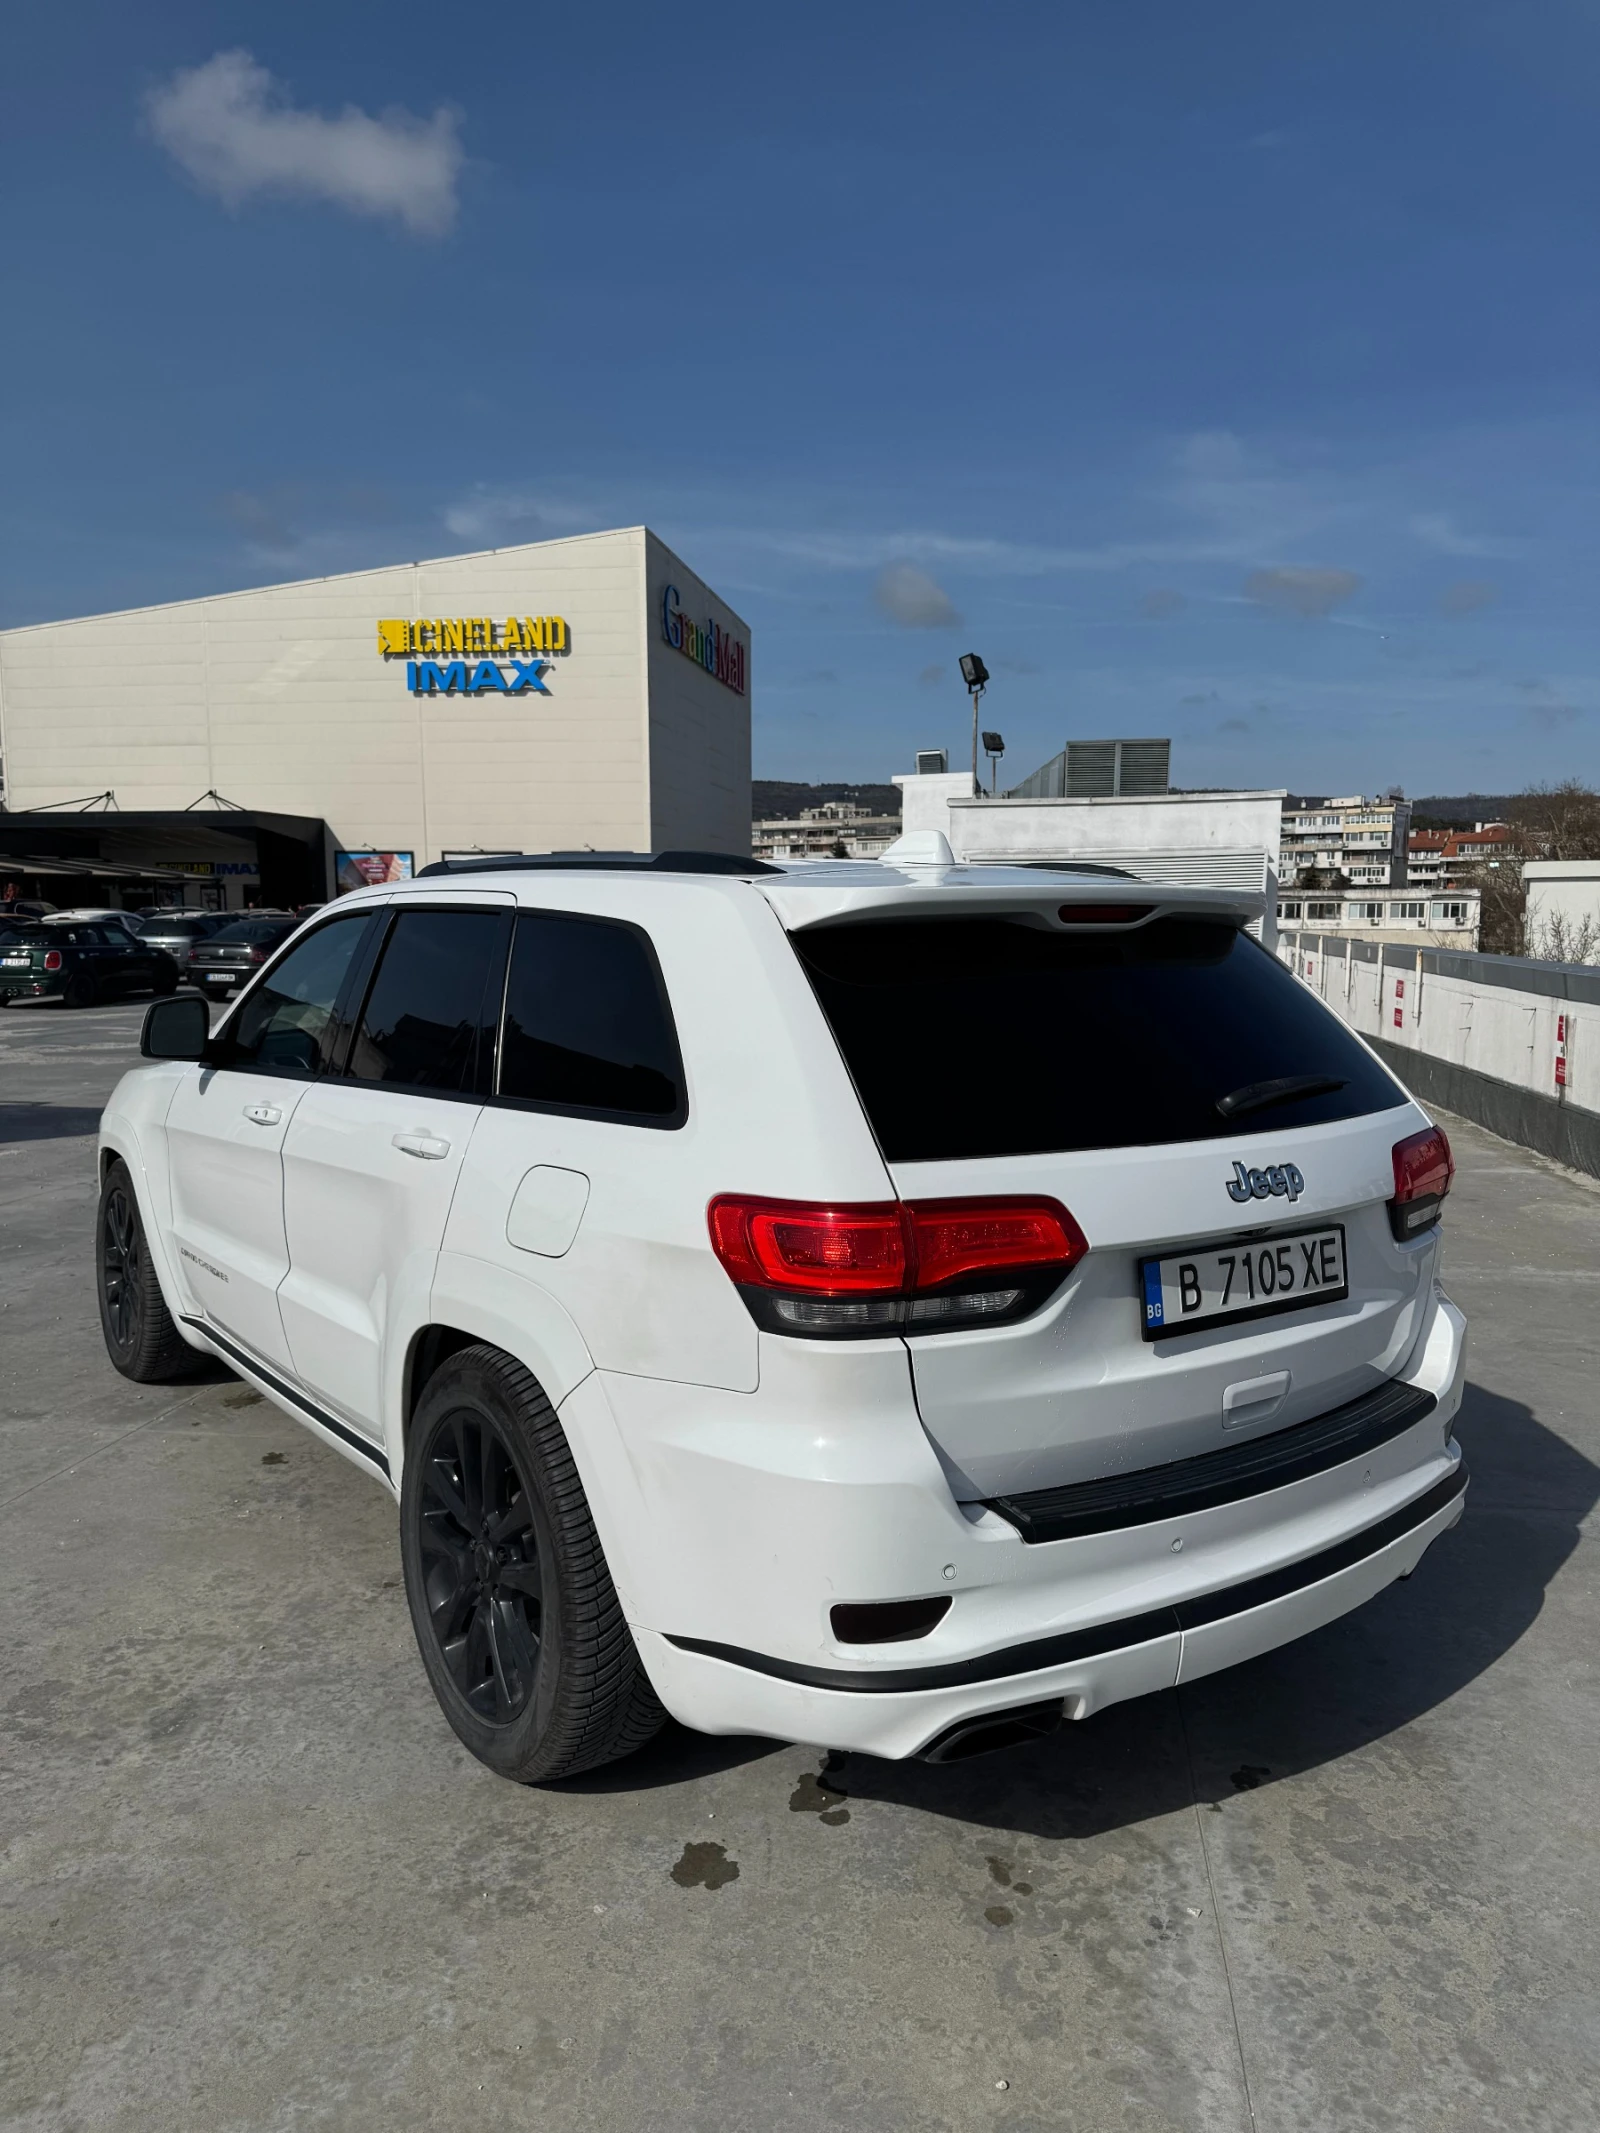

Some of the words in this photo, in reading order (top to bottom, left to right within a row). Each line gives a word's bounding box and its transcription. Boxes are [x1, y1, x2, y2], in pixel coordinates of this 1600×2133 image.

[414, 616, 566, 652] CINELAND
[407, 659, 547, 691] IMAX
[1226, 1160, 1305, 1202] Jeep
[1179, 1263, 1201, 1314] B
[1218, 1246, 1295, 1306] 7105
[1301, 1237, 1339, 1289] XE
[1147, 1304, 1162, 1319] BG
